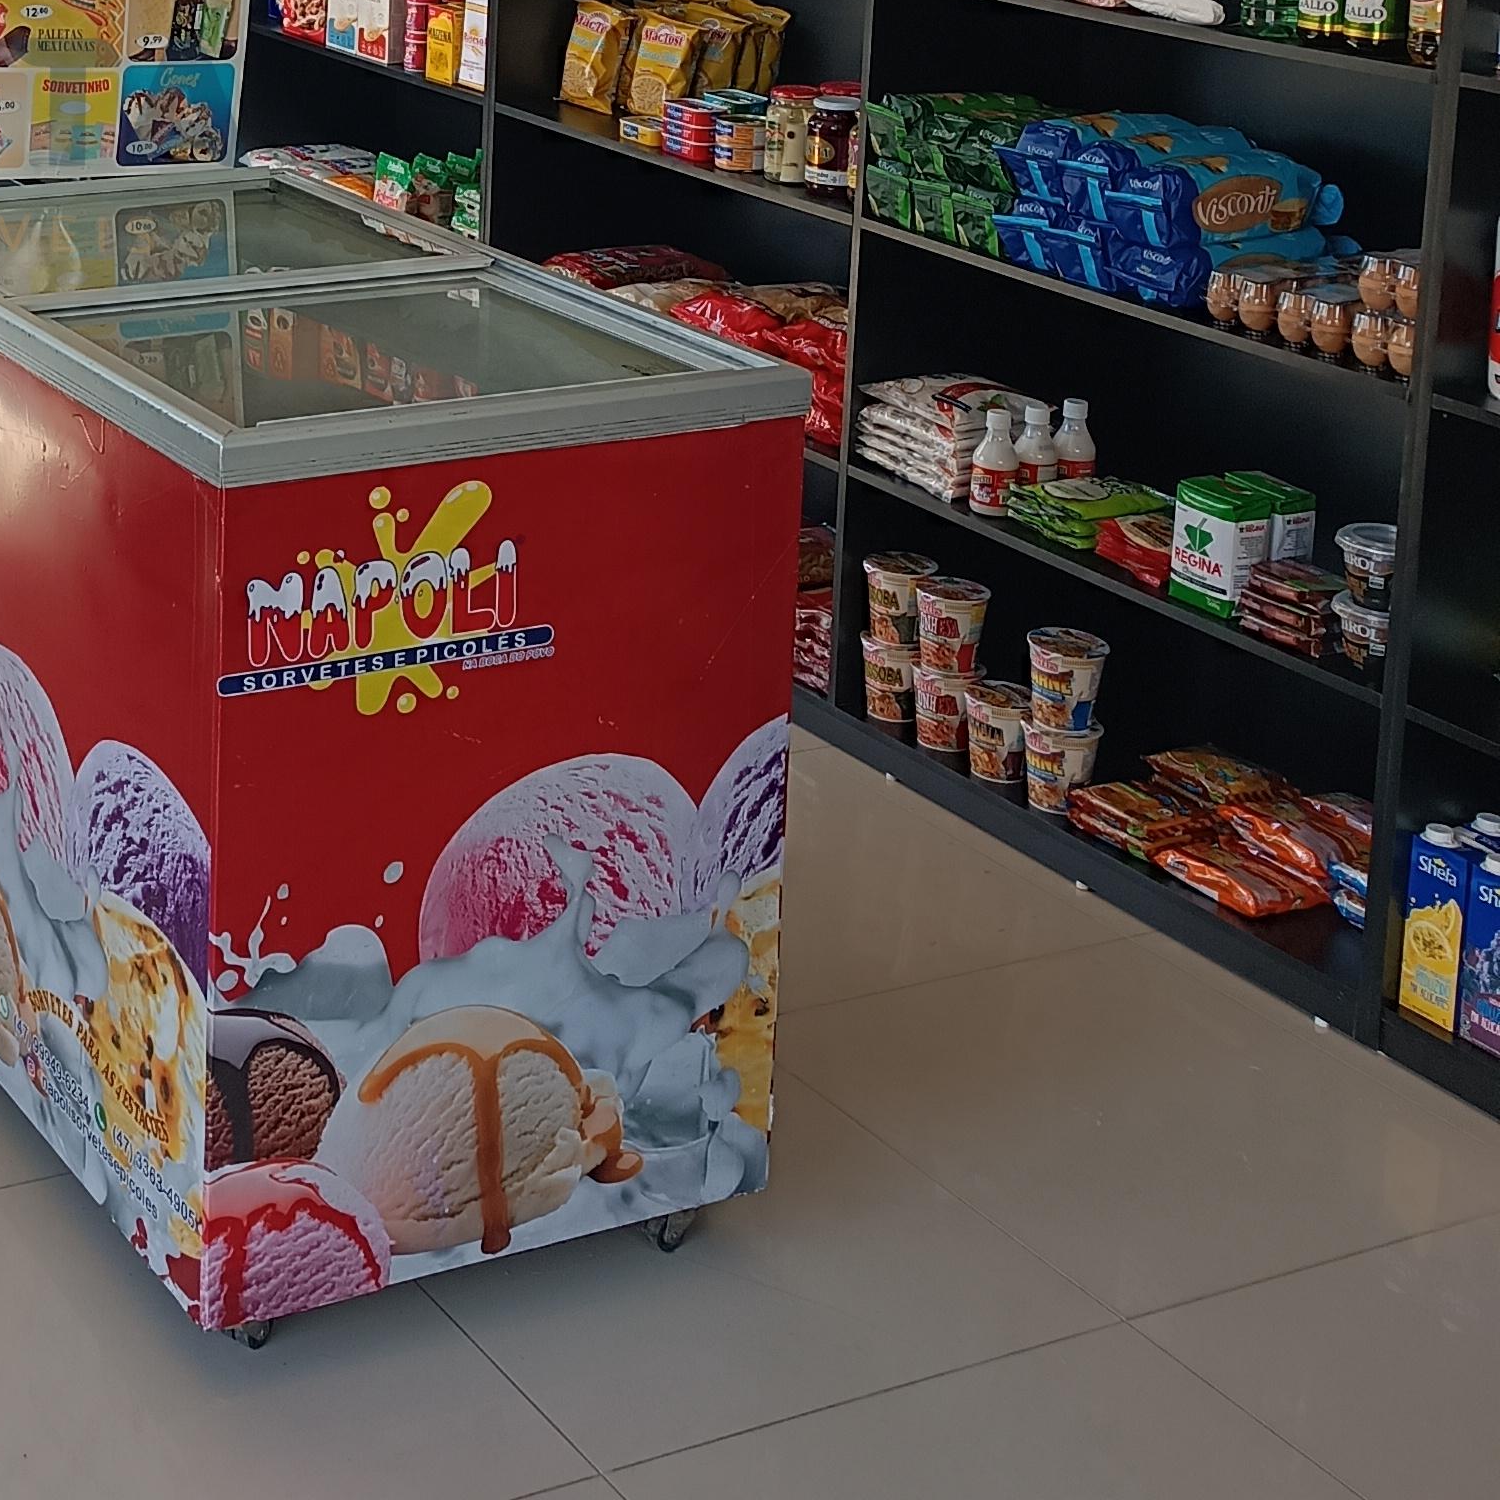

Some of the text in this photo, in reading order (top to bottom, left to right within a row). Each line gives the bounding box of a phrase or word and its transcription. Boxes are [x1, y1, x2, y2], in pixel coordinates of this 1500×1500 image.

[36, 40, 97, 52] MEXICANAS
[38, 29, 84, 40] PALETAS
[643, 28, 686, 46] MacTost
[42, 78, 110, 94] SORVETINHO
[160, 67, 201, 87] Cones
[1197, 184, 1278, 227] Visconti
[1174, 546, 1221, 577] REGINA
[247, 539, 518, 667] NAPOLI
[243, 631, 528, 692] SORVETES E PICOLÉS
[462, 646, 555, 670] NA BOCA DO POVO
[1418, 854, 1457, 888] Shefa
[13, 1015, 90, 1111] (47) 99949-6234
[28, 989, 74, 1029] SORVETES
[76, 1024, 100, 1065] PARA
[101, 1063, 116, 1088] AS
[122, 1091, 170, 1144] ESTAÇÕES
[41, 1076, 160, 1220] napolisorvetesepicoles
[112, 1124, 134, 1163] (47)
